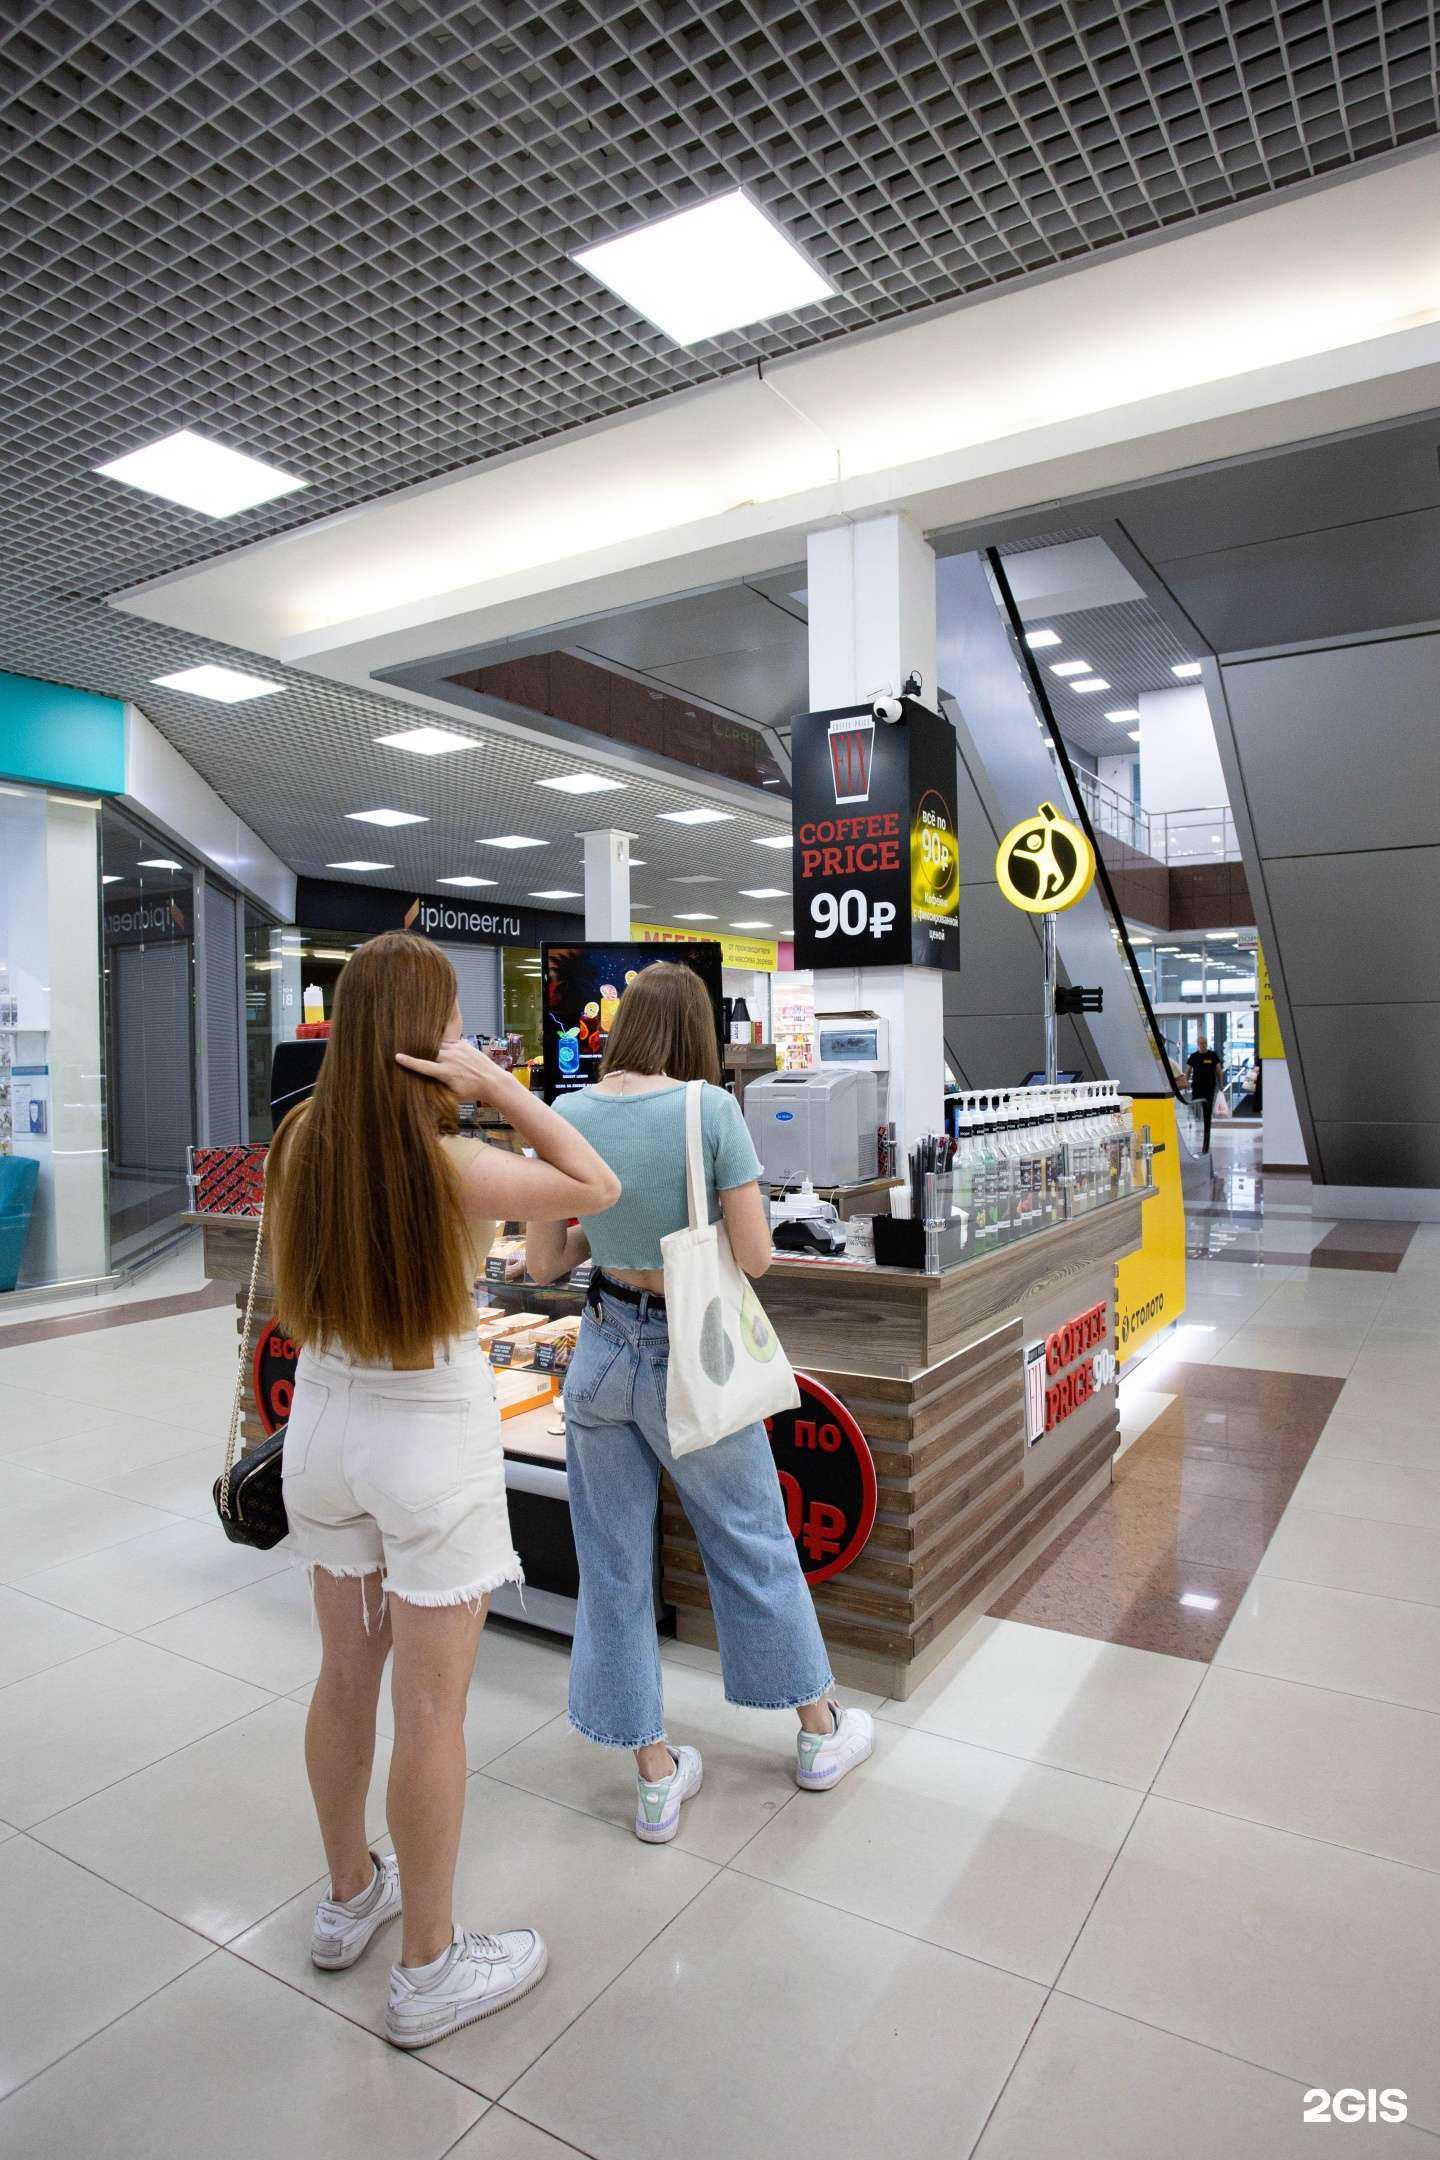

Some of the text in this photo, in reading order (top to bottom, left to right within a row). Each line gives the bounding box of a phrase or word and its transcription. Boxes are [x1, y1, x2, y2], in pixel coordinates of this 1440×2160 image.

[799, 812, 899, 845] COFFEE
[922, 809, 947, 831] всё по
[801, 841, 900, 878] PRICE
[420, 900, 521, 936] ipioneer.ru
[810, 889, 897, 939] 90₽
[1046, 1300, 1108, 1376] COFFEE
[1045, 1357, 1095, 1432] PRICE
